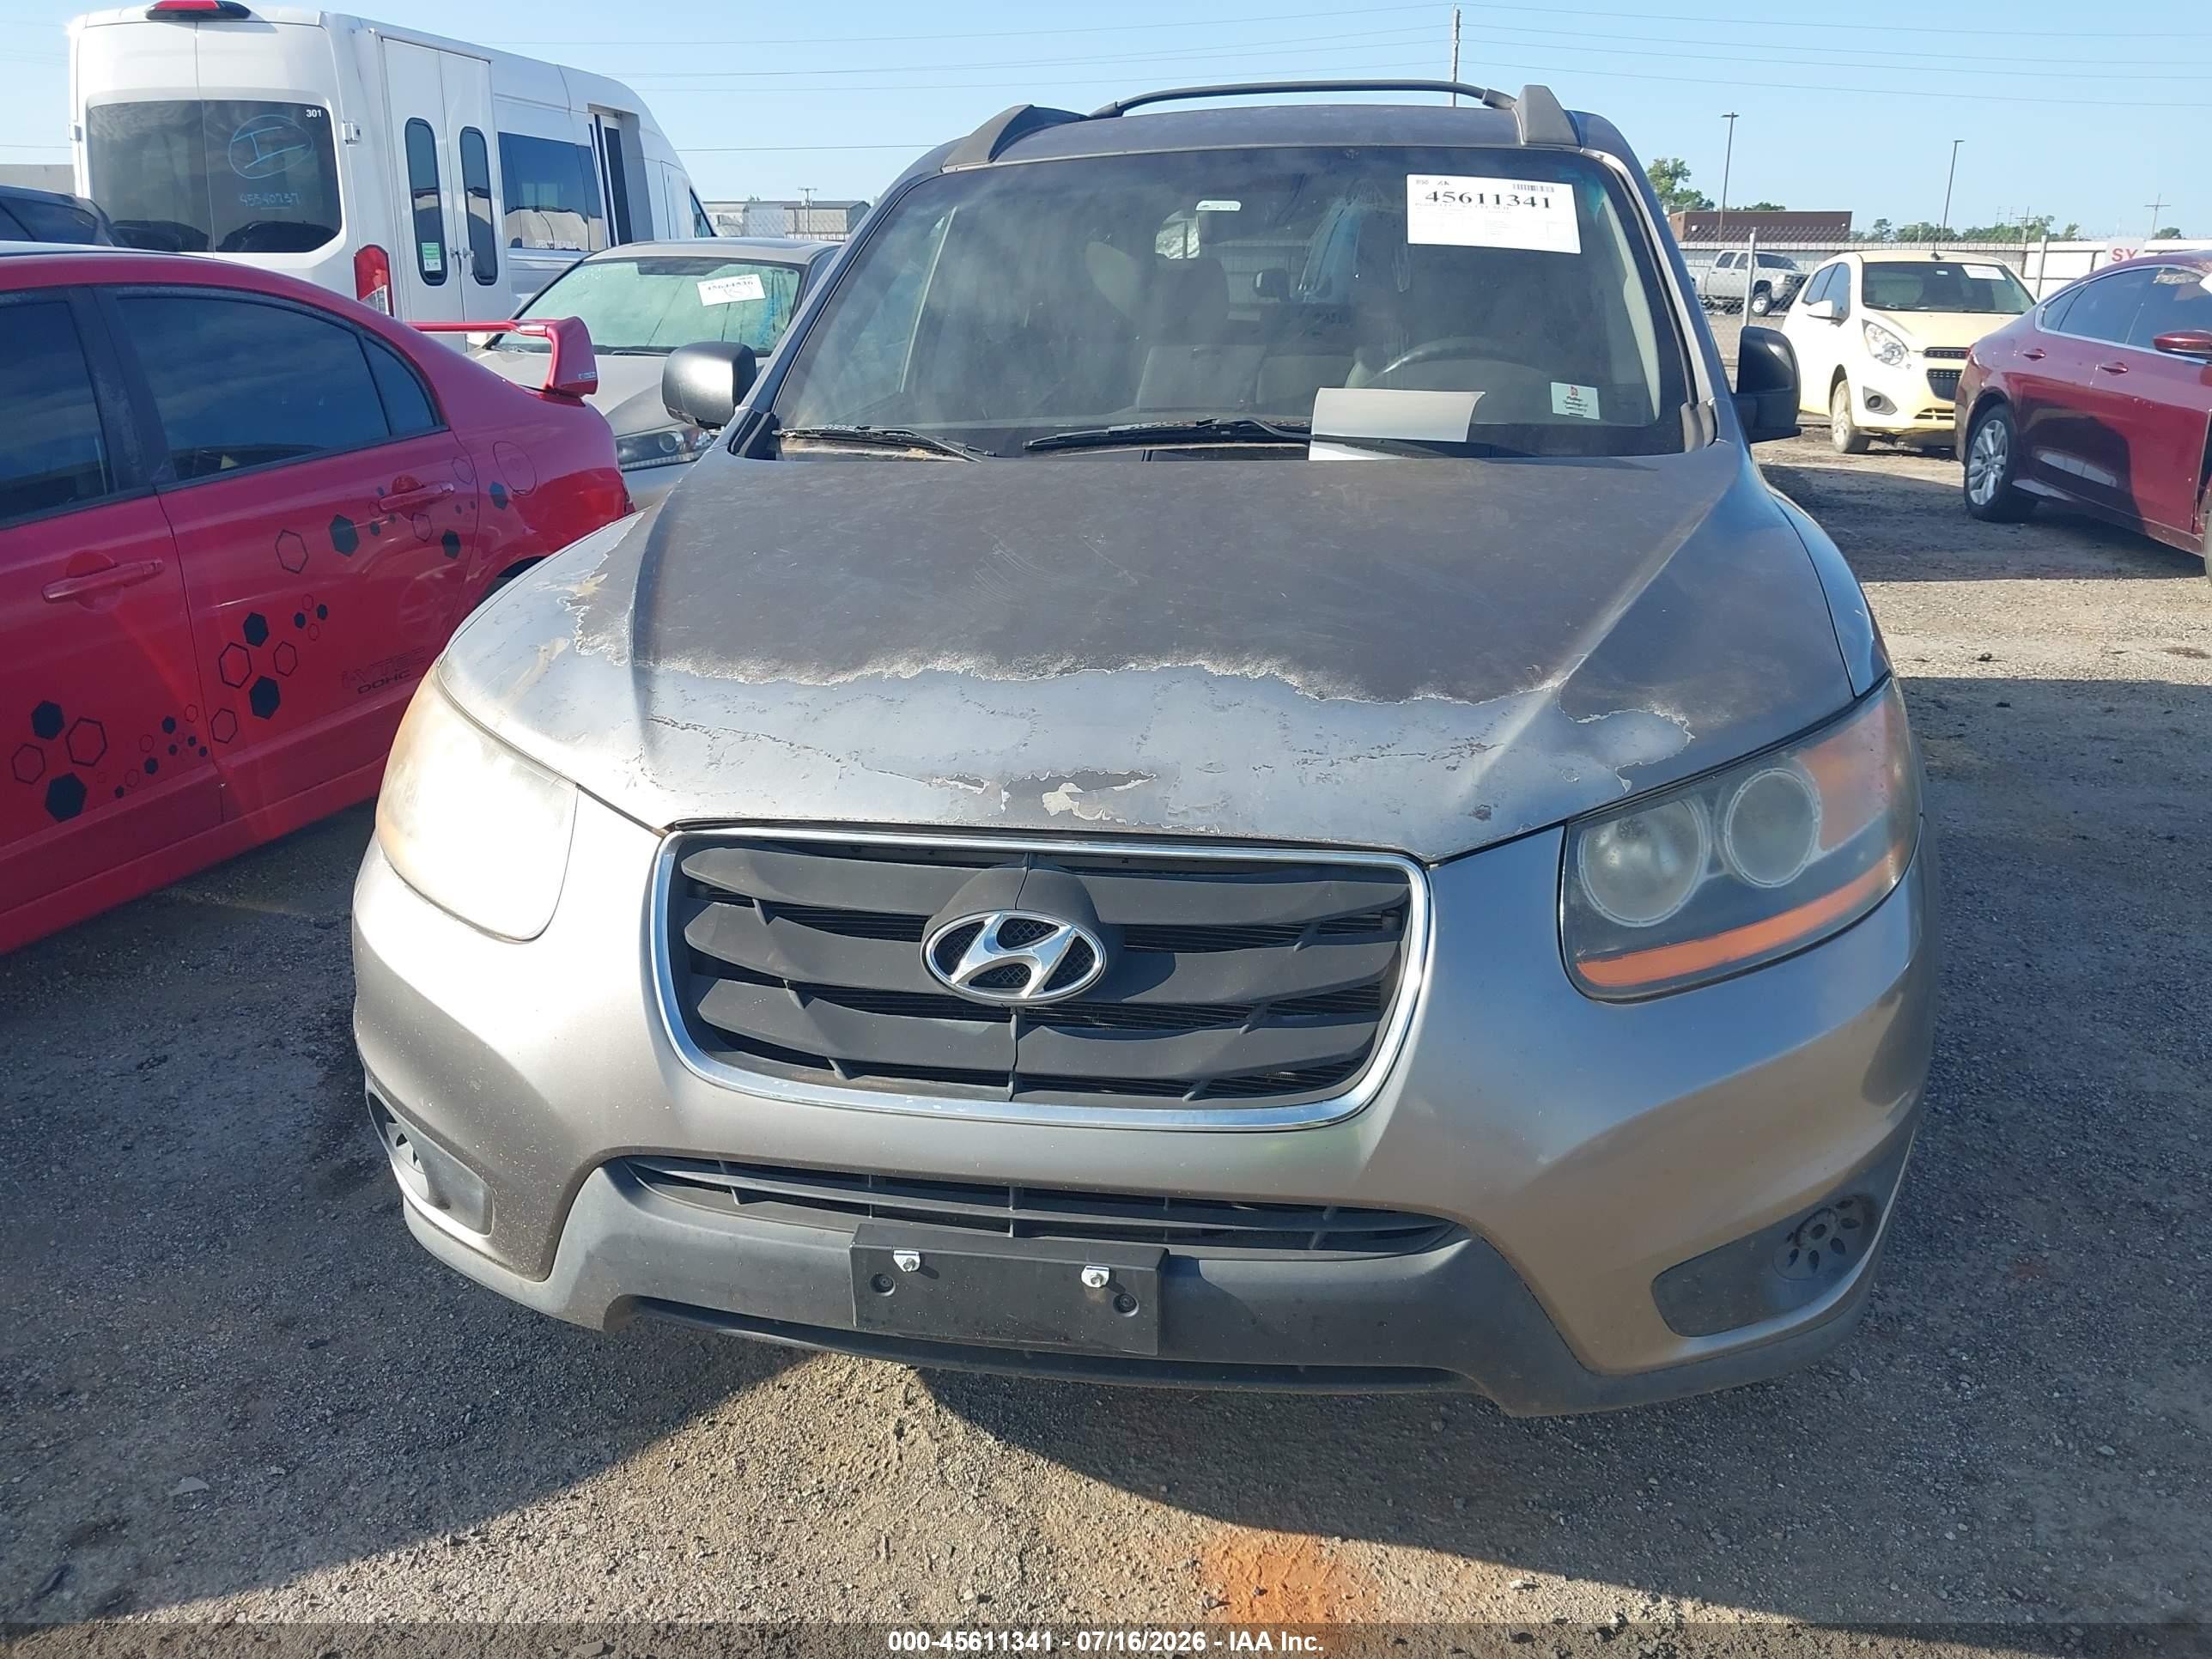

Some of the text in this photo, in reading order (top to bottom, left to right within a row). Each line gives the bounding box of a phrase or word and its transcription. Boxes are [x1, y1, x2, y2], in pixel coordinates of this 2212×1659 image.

[306, 109, 322, 118] 301
[1425, 190, 1552, 210] 45611341
[357, 670, 411, 695] DOHC
